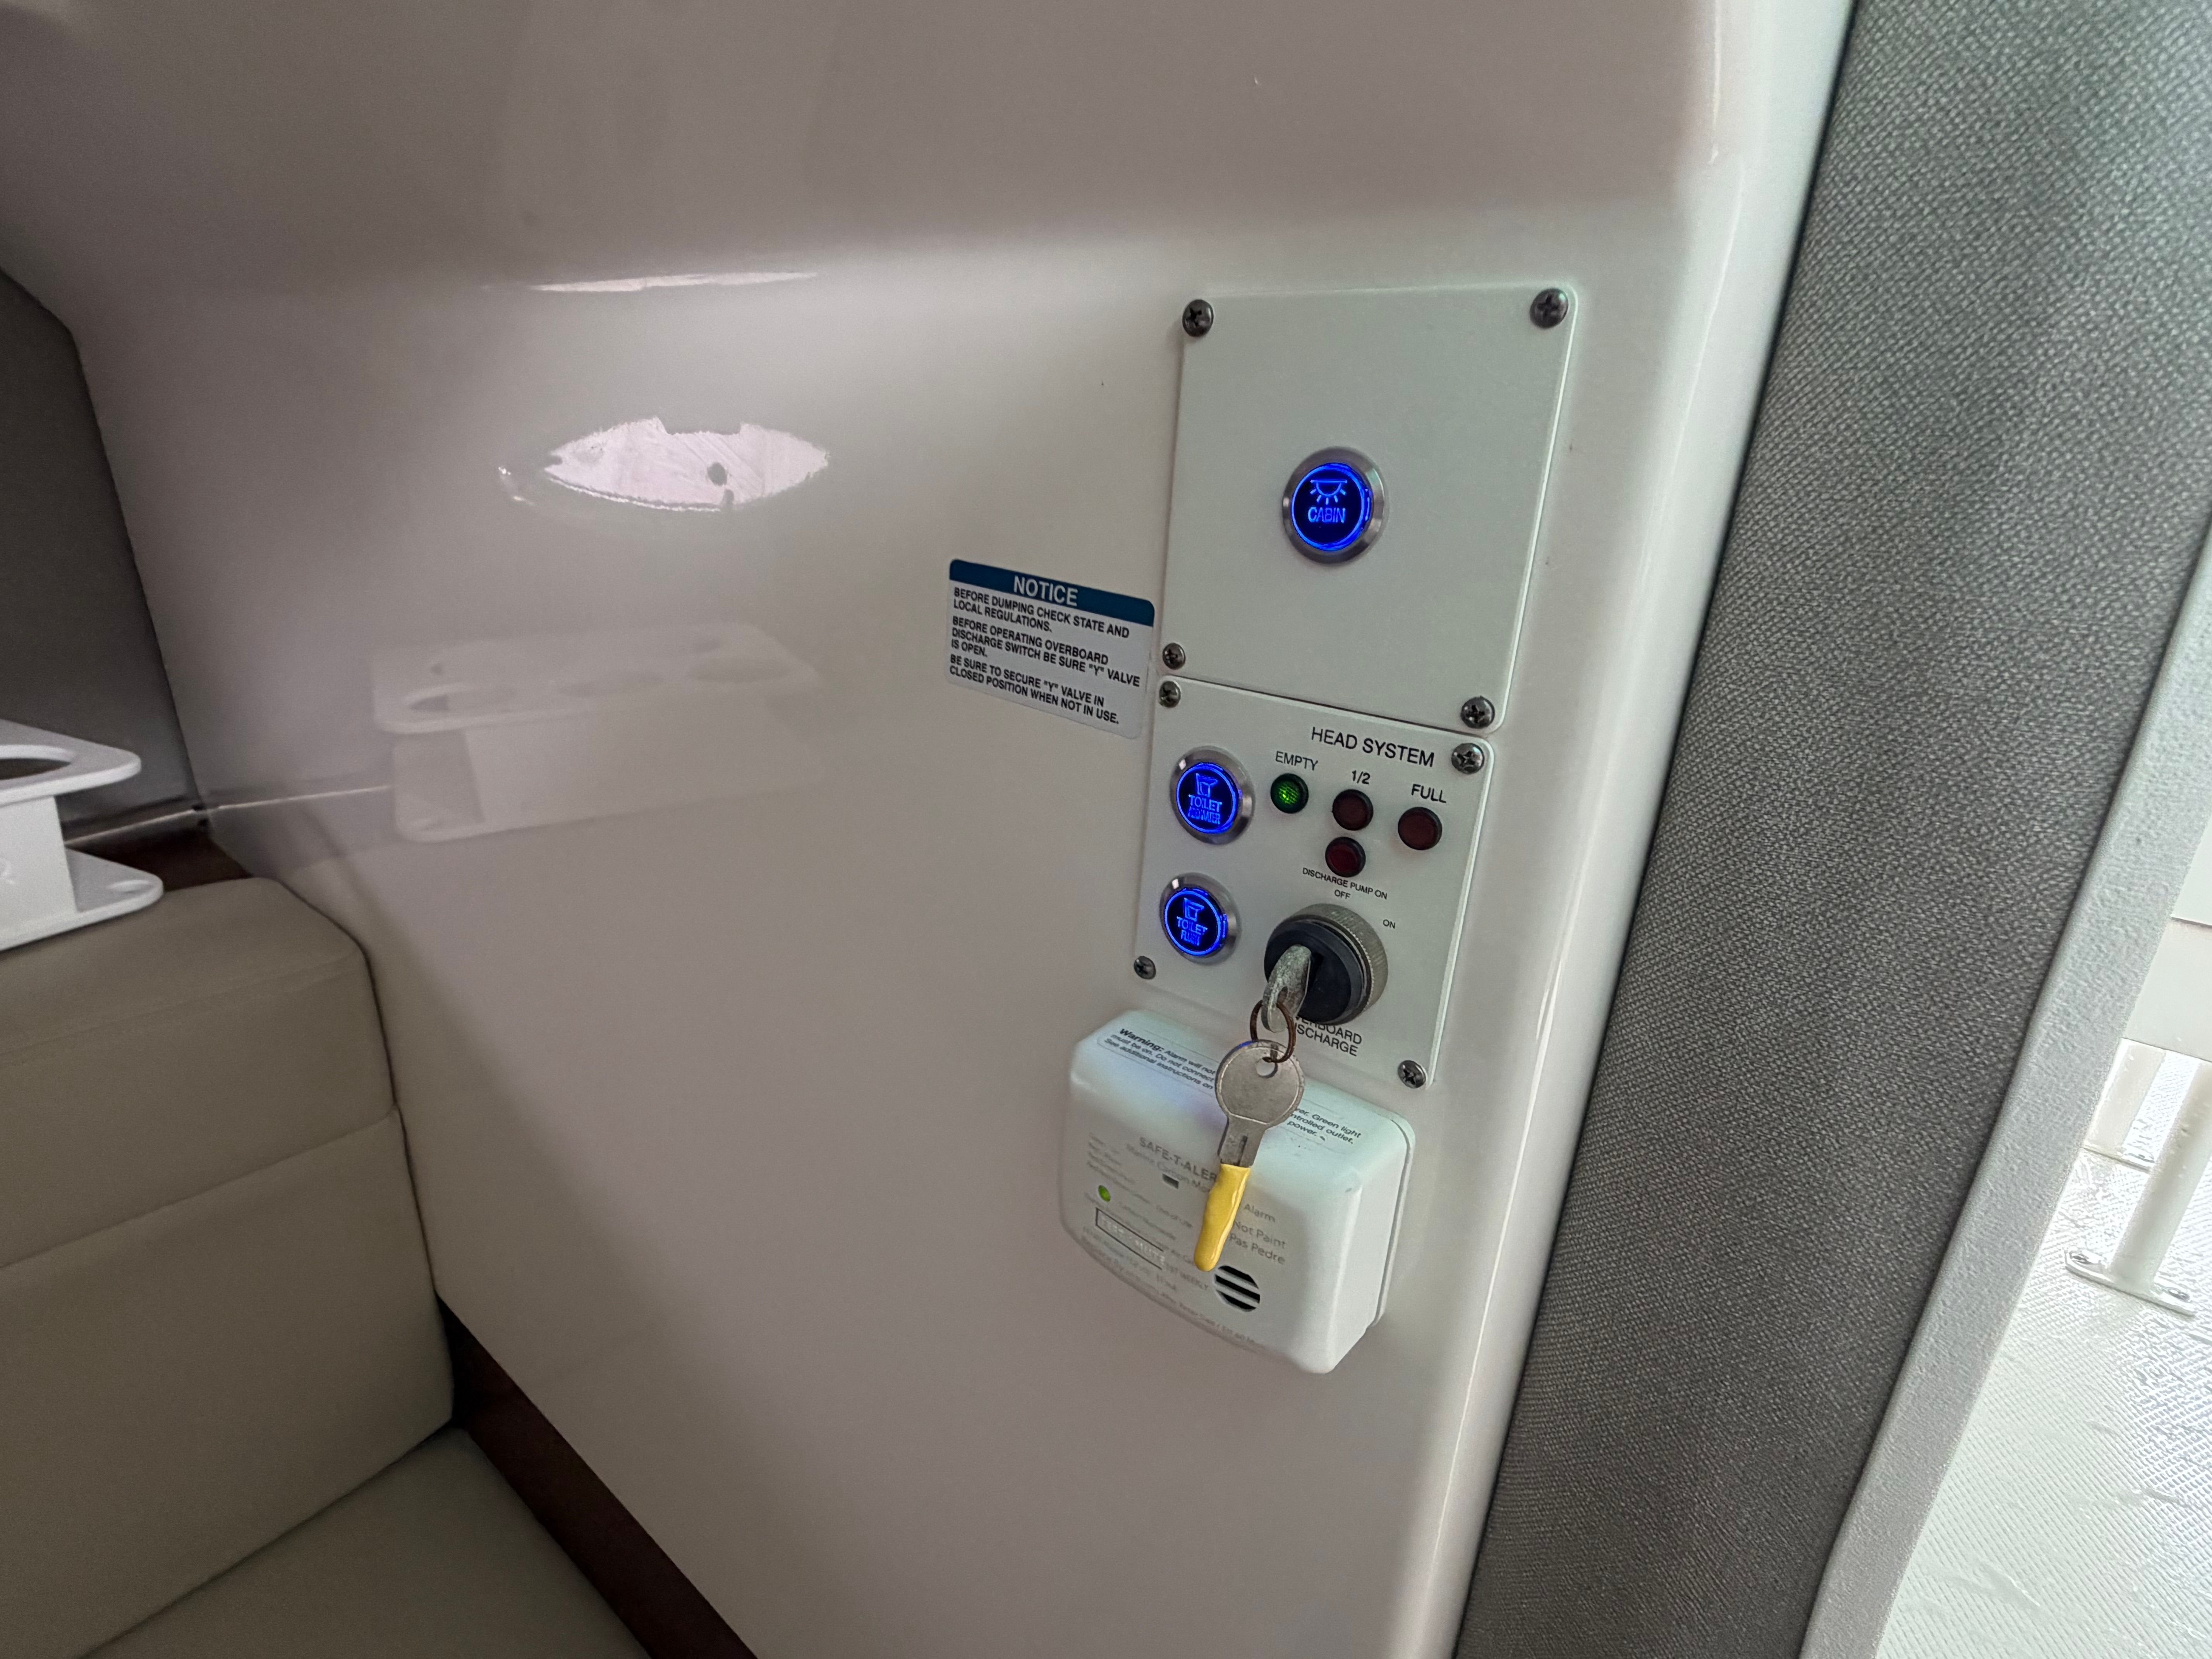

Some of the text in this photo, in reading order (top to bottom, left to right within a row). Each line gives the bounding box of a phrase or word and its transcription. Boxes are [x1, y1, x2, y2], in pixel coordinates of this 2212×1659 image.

[1308, 507, 1346, 523] CABIN
[1013, 575, 1078, 607] NOTICE
[953, 601, 1052, 633] LOCAL REGULATIONS.
[954, 587, 1129, 638] BEFORE DUMPING CHECK STATE AND
[951, 639, 988, 658] IS OPEN.
[953, 616, 1108, 665] BEFORE OPERATING OVERBOARD
[952, 627, 1140, 687] DISCHARGE SWITCH BE SURE "Y" VALVE
[950, 654, 1104, 707] BE SURE TO SECURE "Y" VALVE IN
[950, 666, 1119, 724] CLOSED POSITION WHEN NOT IN USE.
[1275, 750, 1318, 771] EMPTY
[1311, 726, 1434, 768] HEAD SYSTEM
[1352, 770, 1370, 785] 1/2
[1188, 794, 1222, 812] TOILET
[1411, 784, 1447, 803] FULL
[1303, 867, 1388, 900] DISCHARGE PUMP ON
[1334, 890, 1351, 900] OFF
[1176, 916, 1208, 935] TOILET
[1383, 919, 1396, 929] ON
[1295, 1022, 1358, 1056] SCHARGE
[1296, 1015, 1362, 1044] BOARD
[1120, 1029, 1164, 1051] Warning:
[1164, 1051, 1187, 1062] Alarm
[1201, 1067, 1216, 1075] not
[1156, 1062, 1201, 1084] instructions
[1167, 1060, 1182, 1068] not
[1182, 1066, 1214, 1082] connect
[1287, 1121, 1317, 1136] power.
[1290, 1113, 1353, 1144] ntrolled outlet.
[1312, 1114, 1361, 1138] Green light
[1139, 1137, 1217, 1181] SAFE-T-ALER
[1243, 1204, 1276, 1223] Alarm
[1229, 1233, 1286, 1265] Pas Pedre
[1235, 1221, 1286, 1249] Not Paint
